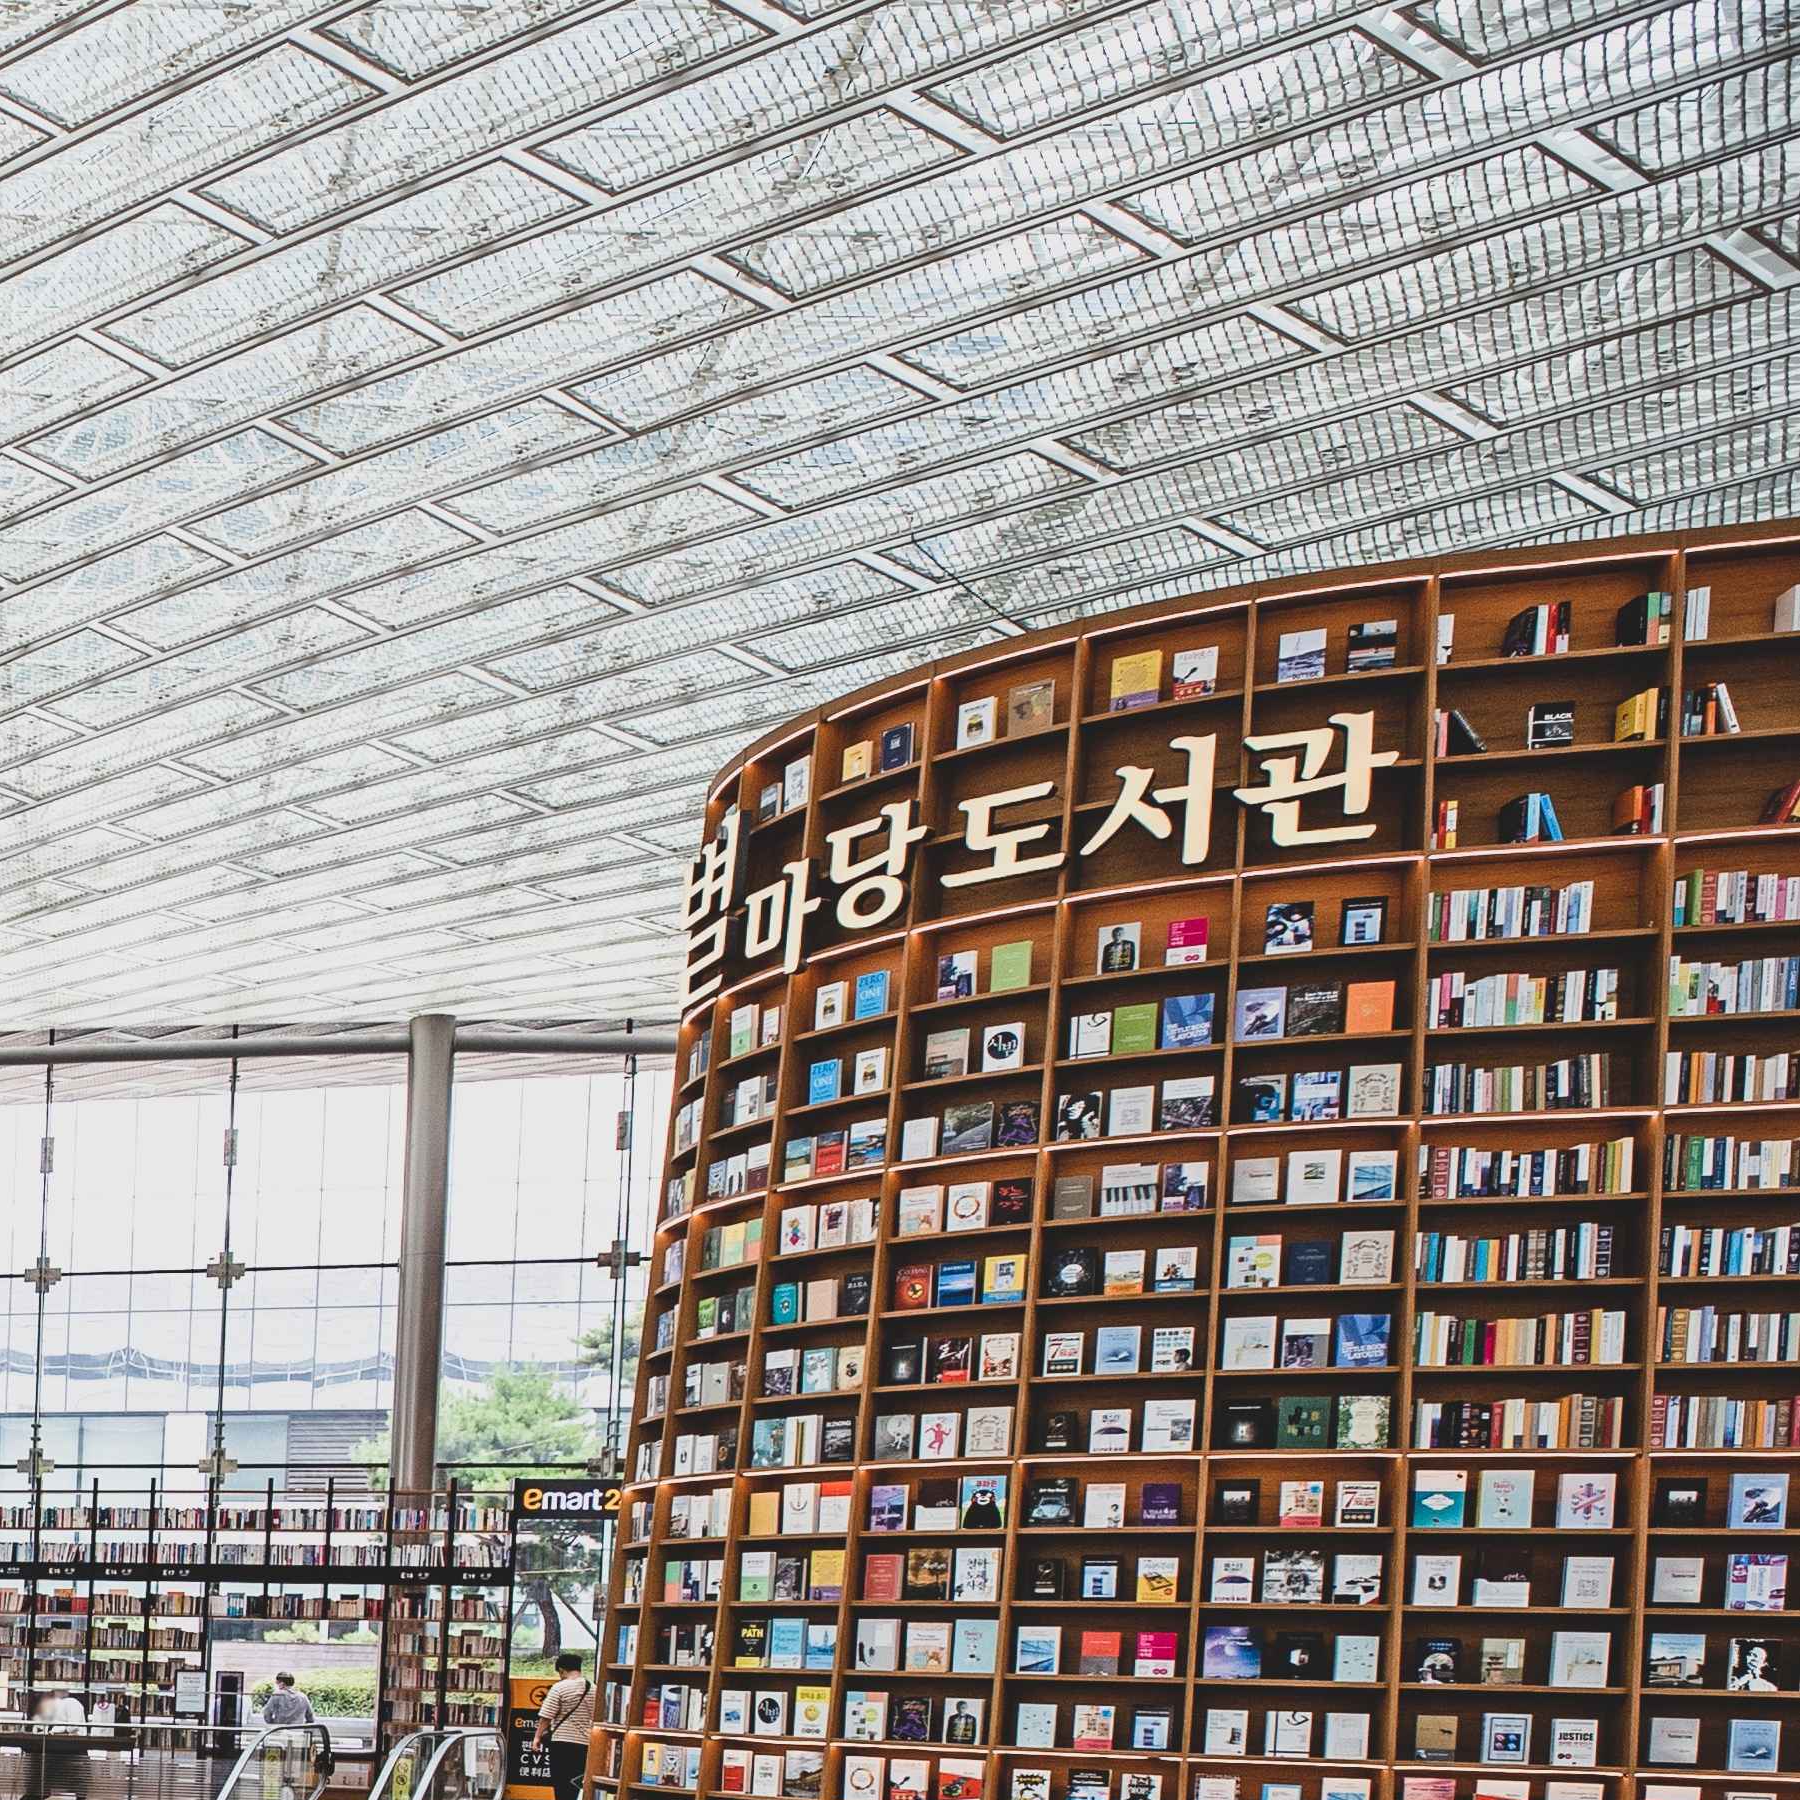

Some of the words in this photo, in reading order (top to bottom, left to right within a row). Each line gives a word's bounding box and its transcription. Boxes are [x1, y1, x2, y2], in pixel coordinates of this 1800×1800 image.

[1544, 712, 1573, 721] BLACK
[523, 1488, 623, 1511] emart2
[1558, 1732, 1594, 1741] JUSTICE
